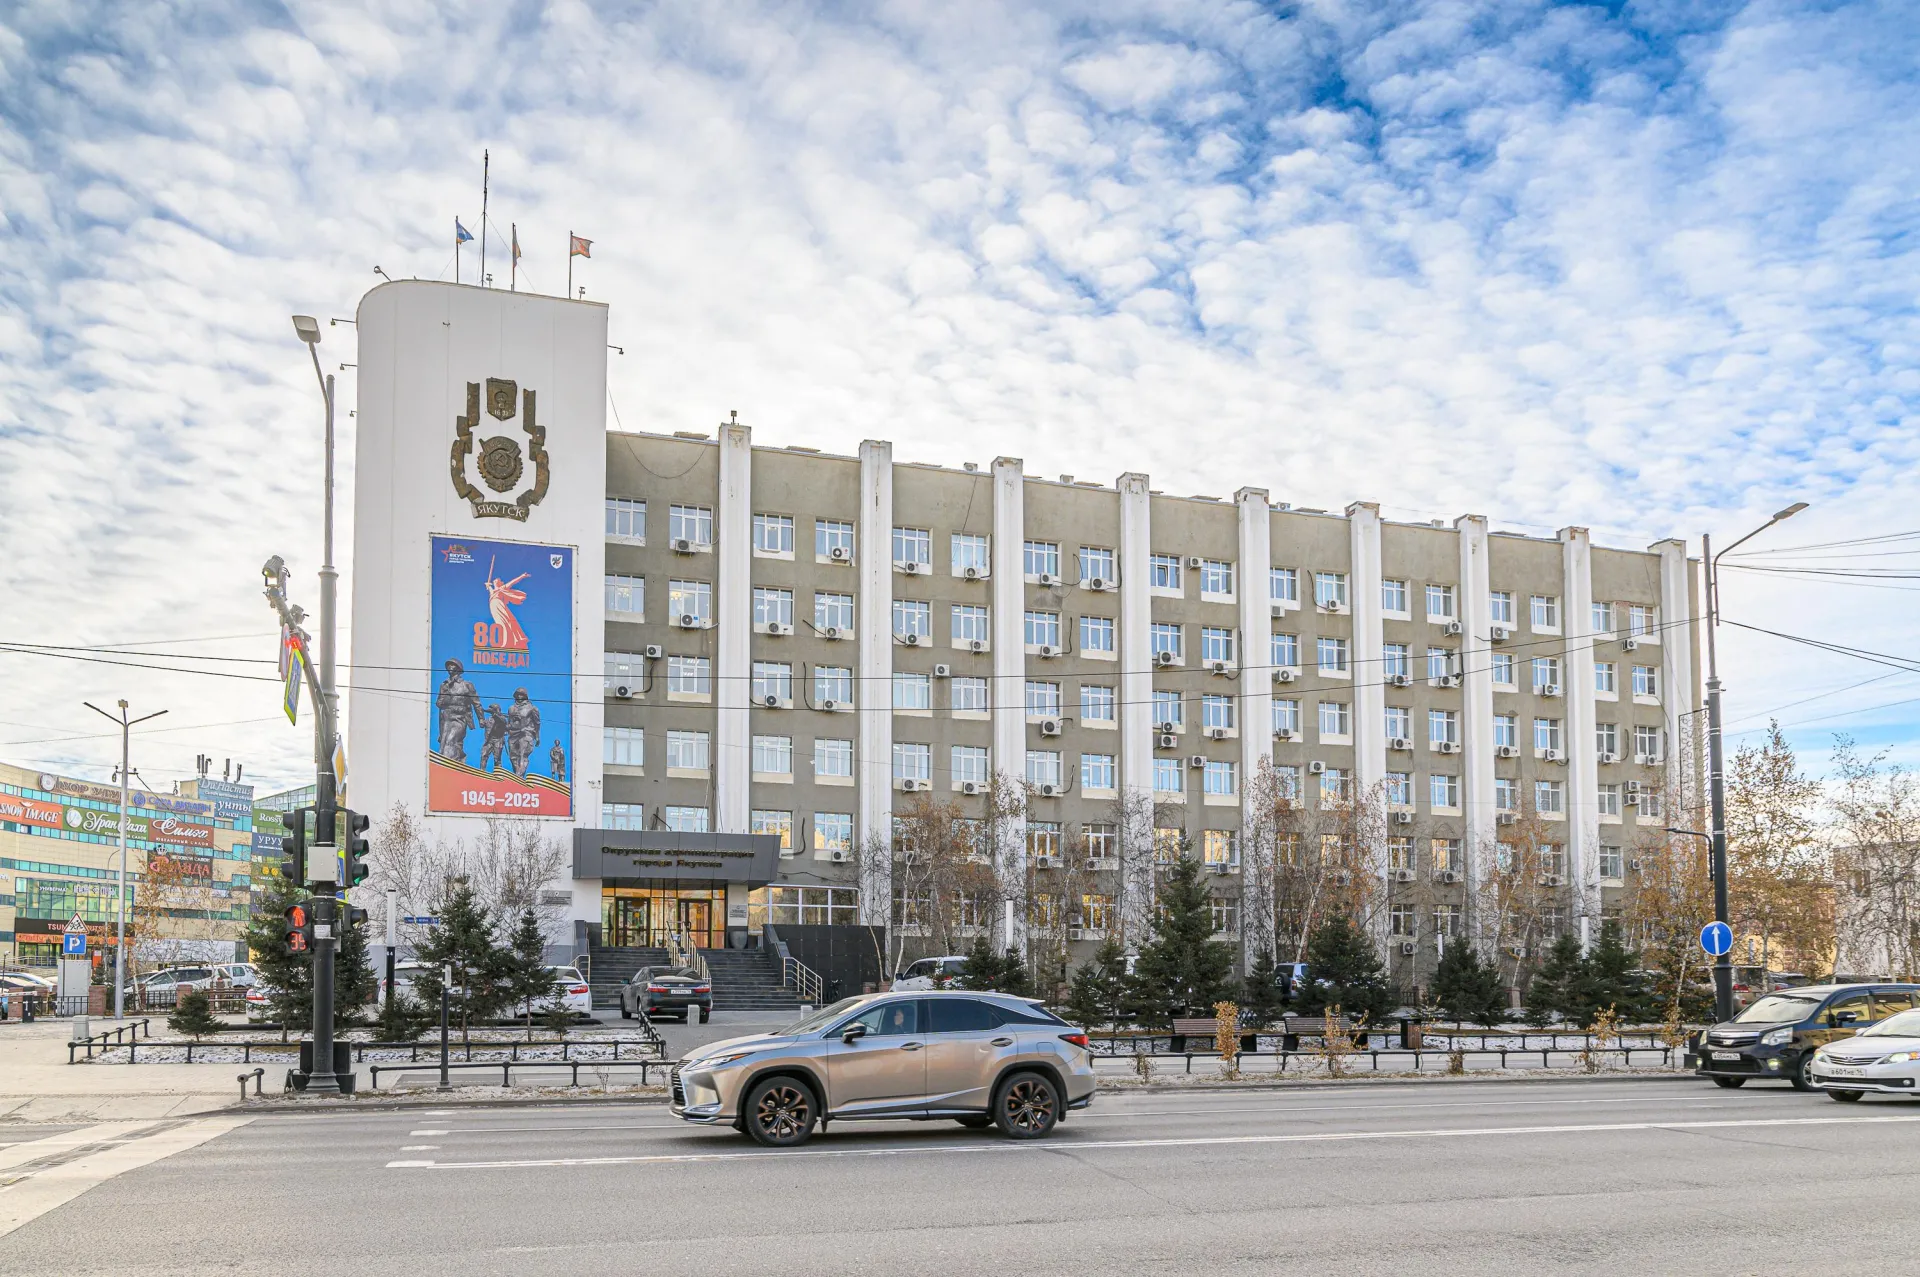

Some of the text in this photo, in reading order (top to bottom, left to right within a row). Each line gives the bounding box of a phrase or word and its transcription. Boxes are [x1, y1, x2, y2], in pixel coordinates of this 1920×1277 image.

[477, 505, 524, 517] ЯКУТСК
[473, 621, 504, 648] 80
[473, 651, 530, 668] ПОБЕДА!
[0, 802, 59, 823] SNOW IMAGE
[83, 812, 118, 832] Уран
[153, 817, 208, 838] Симэх
[601, 846, 755, 858] Окружная администрация
[632, 859, 723, 868] города Якутска
[290, 933, 306, 950] 35
